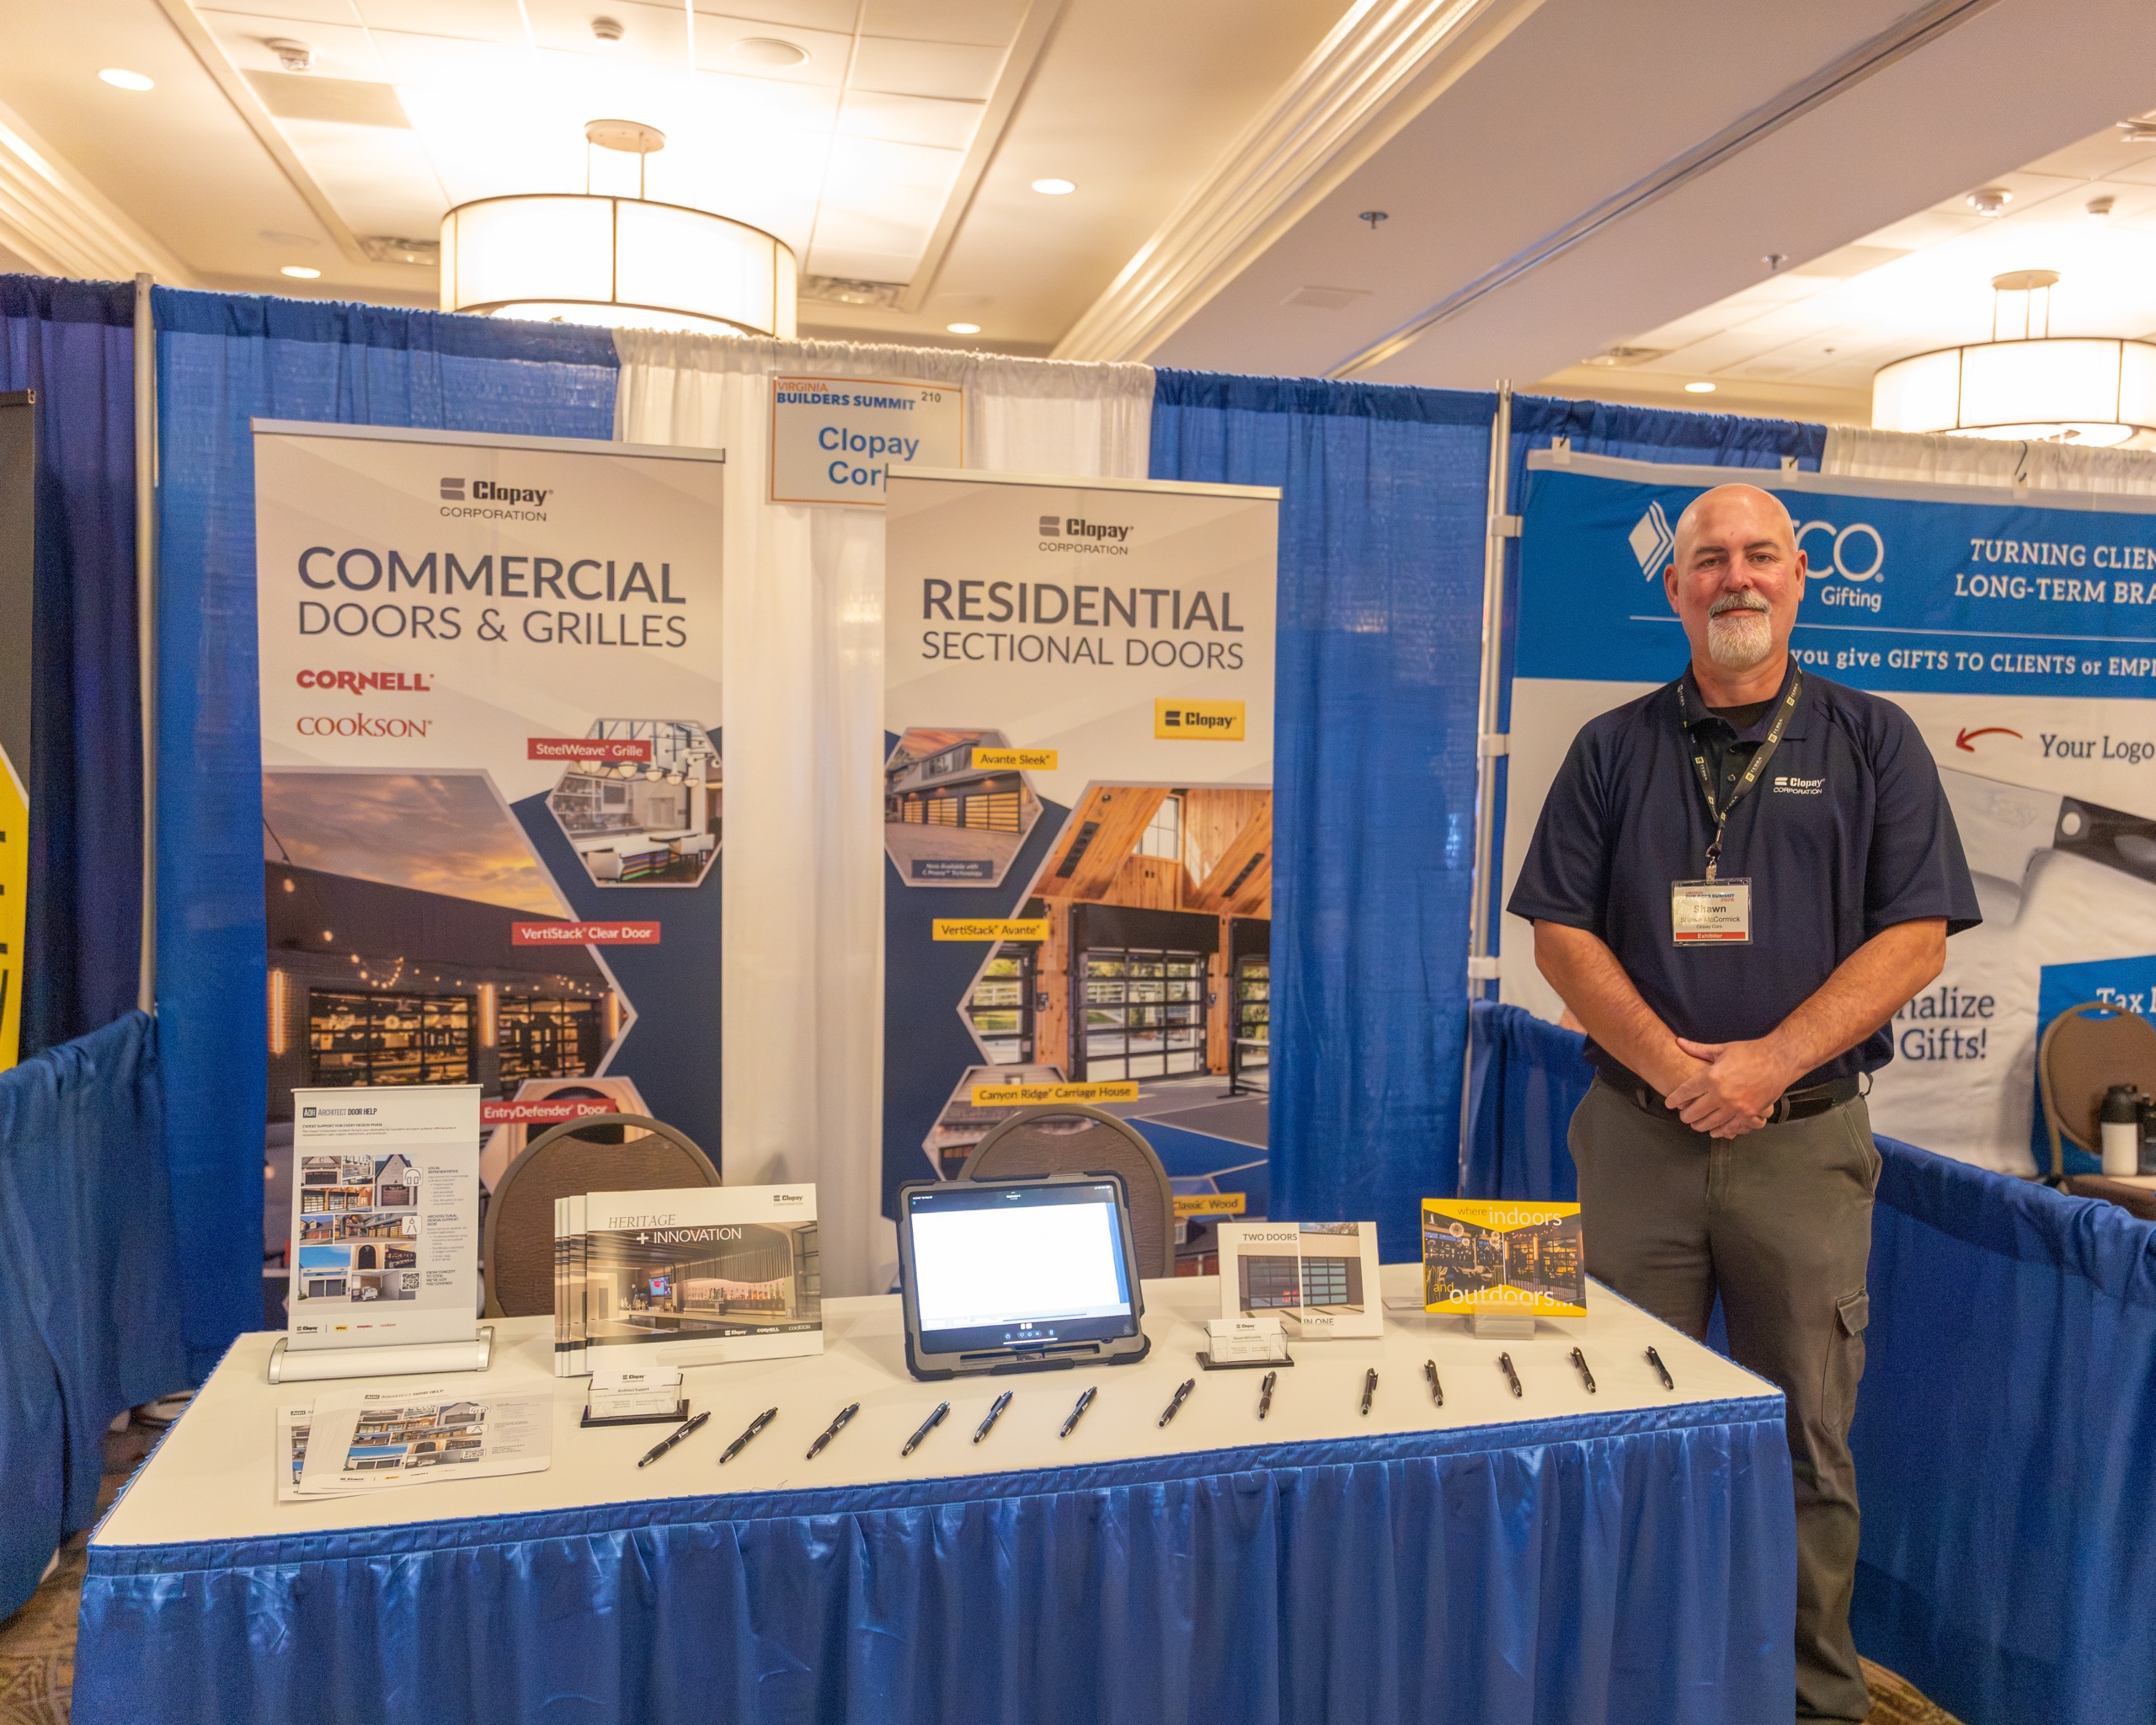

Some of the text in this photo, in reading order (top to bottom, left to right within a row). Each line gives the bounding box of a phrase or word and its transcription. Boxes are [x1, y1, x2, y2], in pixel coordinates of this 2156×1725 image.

[778, 382, 828, 392] VIRGINIA
[776, 393, 915, 410] BUILDERS SUMMIT
[921, 392, 942, 403] 210
[819, 426, 920, 462] Clopay
[828, 461, 886, 493] Cor
[472, 480, 547, 506] Clopay
[440, 507, 547, 522] CORPORATION
[1066, 518, 1129, 541] Clopay
[1038, 542, 1129, 556] CORPORATION
[1971, 538, 2087, 568] TURNING
[297, 546, 686, 606] COMMERCIAL
[1955, 574, 2107, 603] LONG-TERM
[923, 578, 1244, 633] RESIDENTIAL
[1821, 585, 1882, 613] Gifting
[299, 601, 686, 648] DOORS & GRILLES
[921, 631, 1244, 670] SECTIONAL DOORS
[1790, 649, 1829, 665] you
[1836, 648, 1881, 670] give
[1887, 649, 1949, 670] GIFTS
[1955, 651, 1984, 671] TO
[1990, 654, 2075, 675] CLIENTS
[2081, 660, 2102, 675] or
[296, 670, 430, 696] CORNELL
[1185, 712, 1233, 729] Clopay
[1772, 718, 1784, 734] TERRA
[536, 743, 644, 756] SteelWeave Grille
[2040, 734, 2156, 764] Your Logo
[980, 754, 1047, 766] Avante Sleek
[1750, 756, 1763, 773] TERRA
[1790, 777, 1822, 788] Clopay
[520, 927, 654, 940] VertiStack Clear Door
[941, 924, 1038, 936] VertiStack Avante
[2096, 987, 2144, 1013] Tax
[1900, 1028, 1987, 1061] Gifts!
[979, 1087, 1132, 1102] Canyon Ridge Carriage House
[483, 1104, 608, 1119] EntryDefender Door
[1209, 1199, 1238, 1210] Wood
[608, 1214, 676, 1229] HERITAGE
[1457, 1206, 1562, 1226] where indoors
[654, 1227, 742, 1244] INNOVATION
[1433, 1282, 1454, 1293] and
